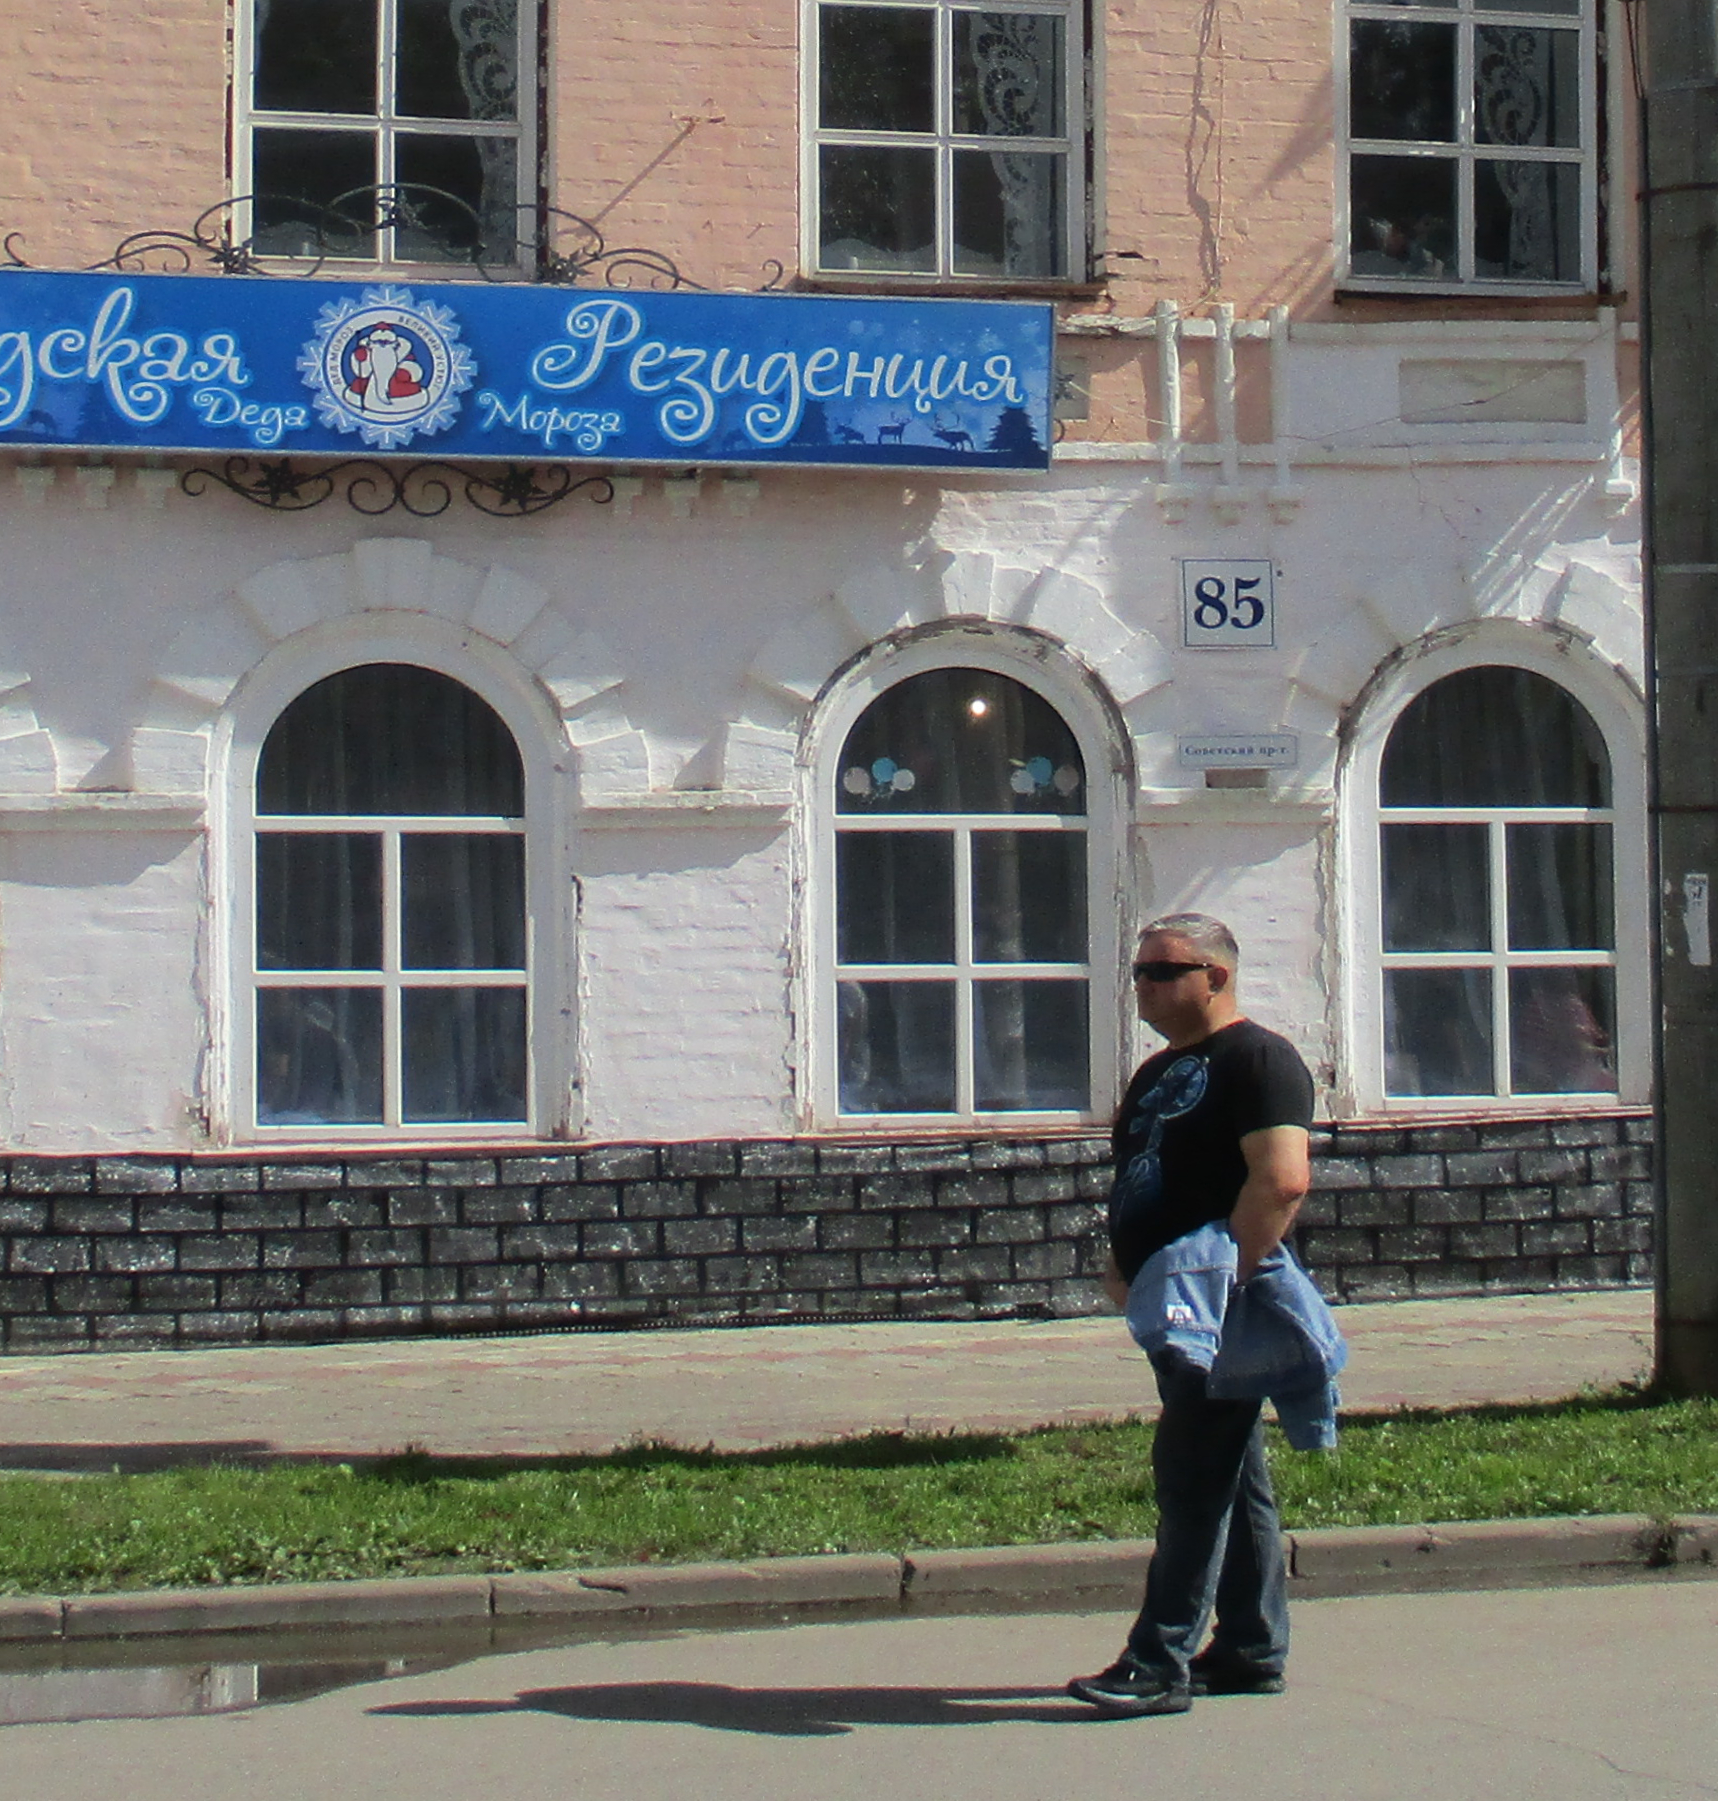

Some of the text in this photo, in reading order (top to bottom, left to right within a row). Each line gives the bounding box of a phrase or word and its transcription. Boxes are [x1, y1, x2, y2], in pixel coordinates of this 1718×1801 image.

[398, 315, 441, 352] ВЕЛИКИЙ
[531, 299, 1024, 443] Резиденция
[193, 387, 622, 451] Деда Мороза
[1193, 576, 1265, 630] 85
[1185, 744, 1254, 756] Советский
